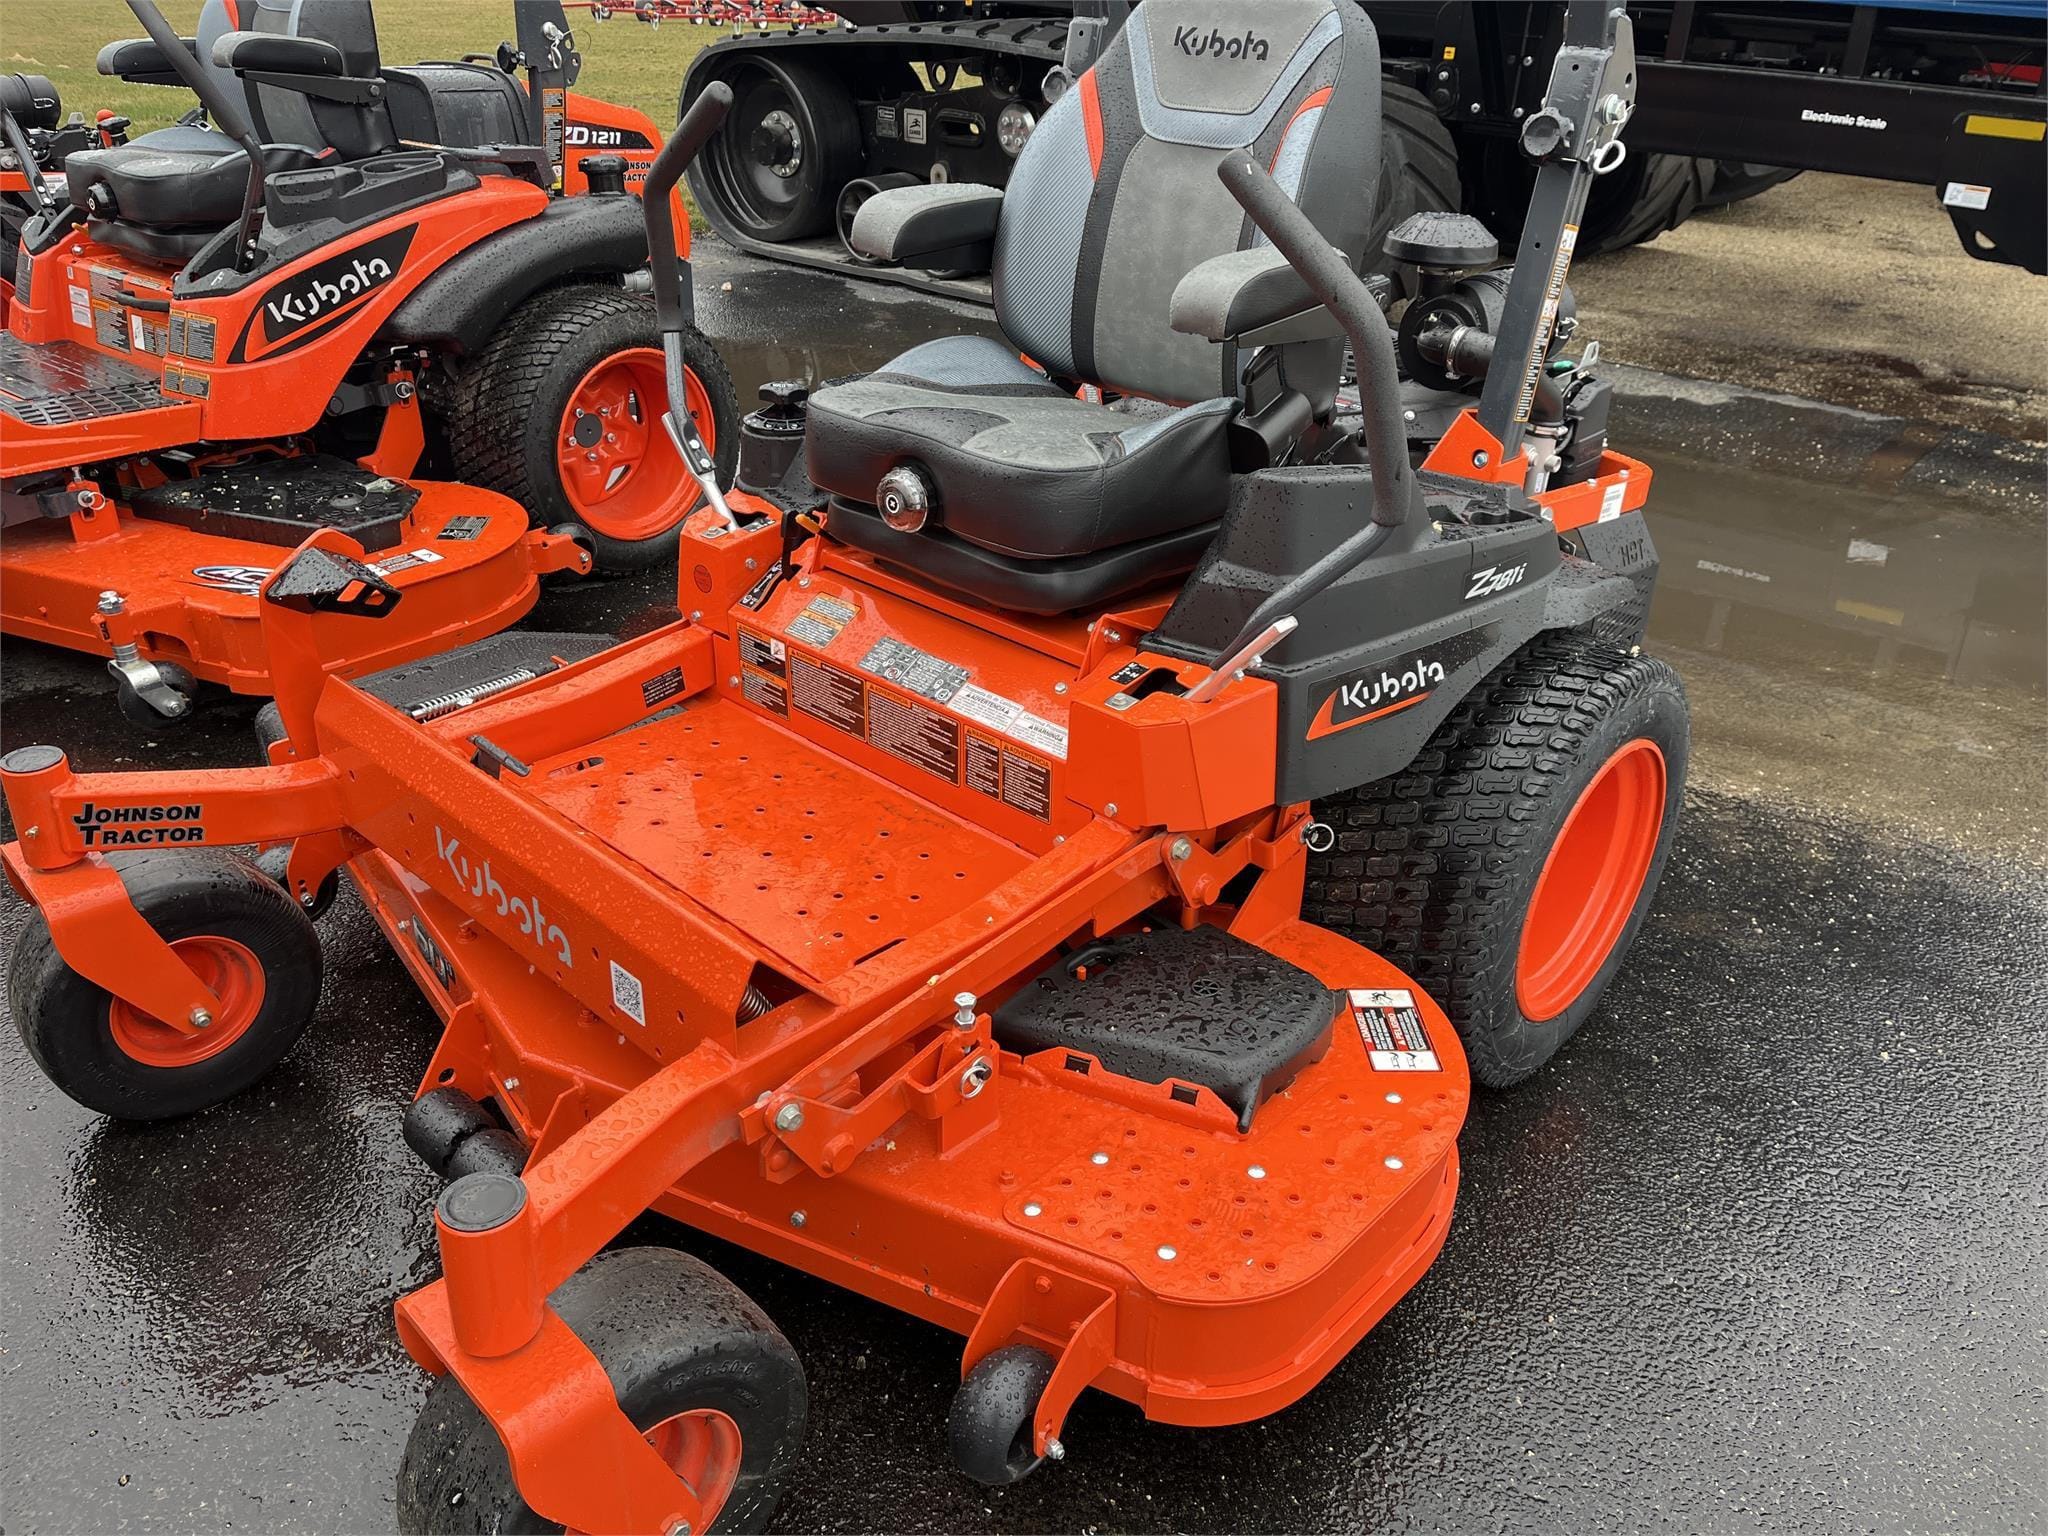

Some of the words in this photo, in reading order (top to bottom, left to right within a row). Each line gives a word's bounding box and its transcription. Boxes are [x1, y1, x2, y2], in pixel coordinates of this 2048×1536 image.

[1173, 25, 1269, 61] Kubota
[1801, 109, 1855, 126] Electronic
[592, 131, 621, 144] 1211
[267, 257, 392, 323] Kubota
[1464, 562, 1528, 600] Z781i
[1342, 658, 1446, 709] Kubota
[73, 802, 202, 825] JOHNSON
[79, 824, 204, 846] TRACTOR
[434, 825, 573, 969] Kubota
